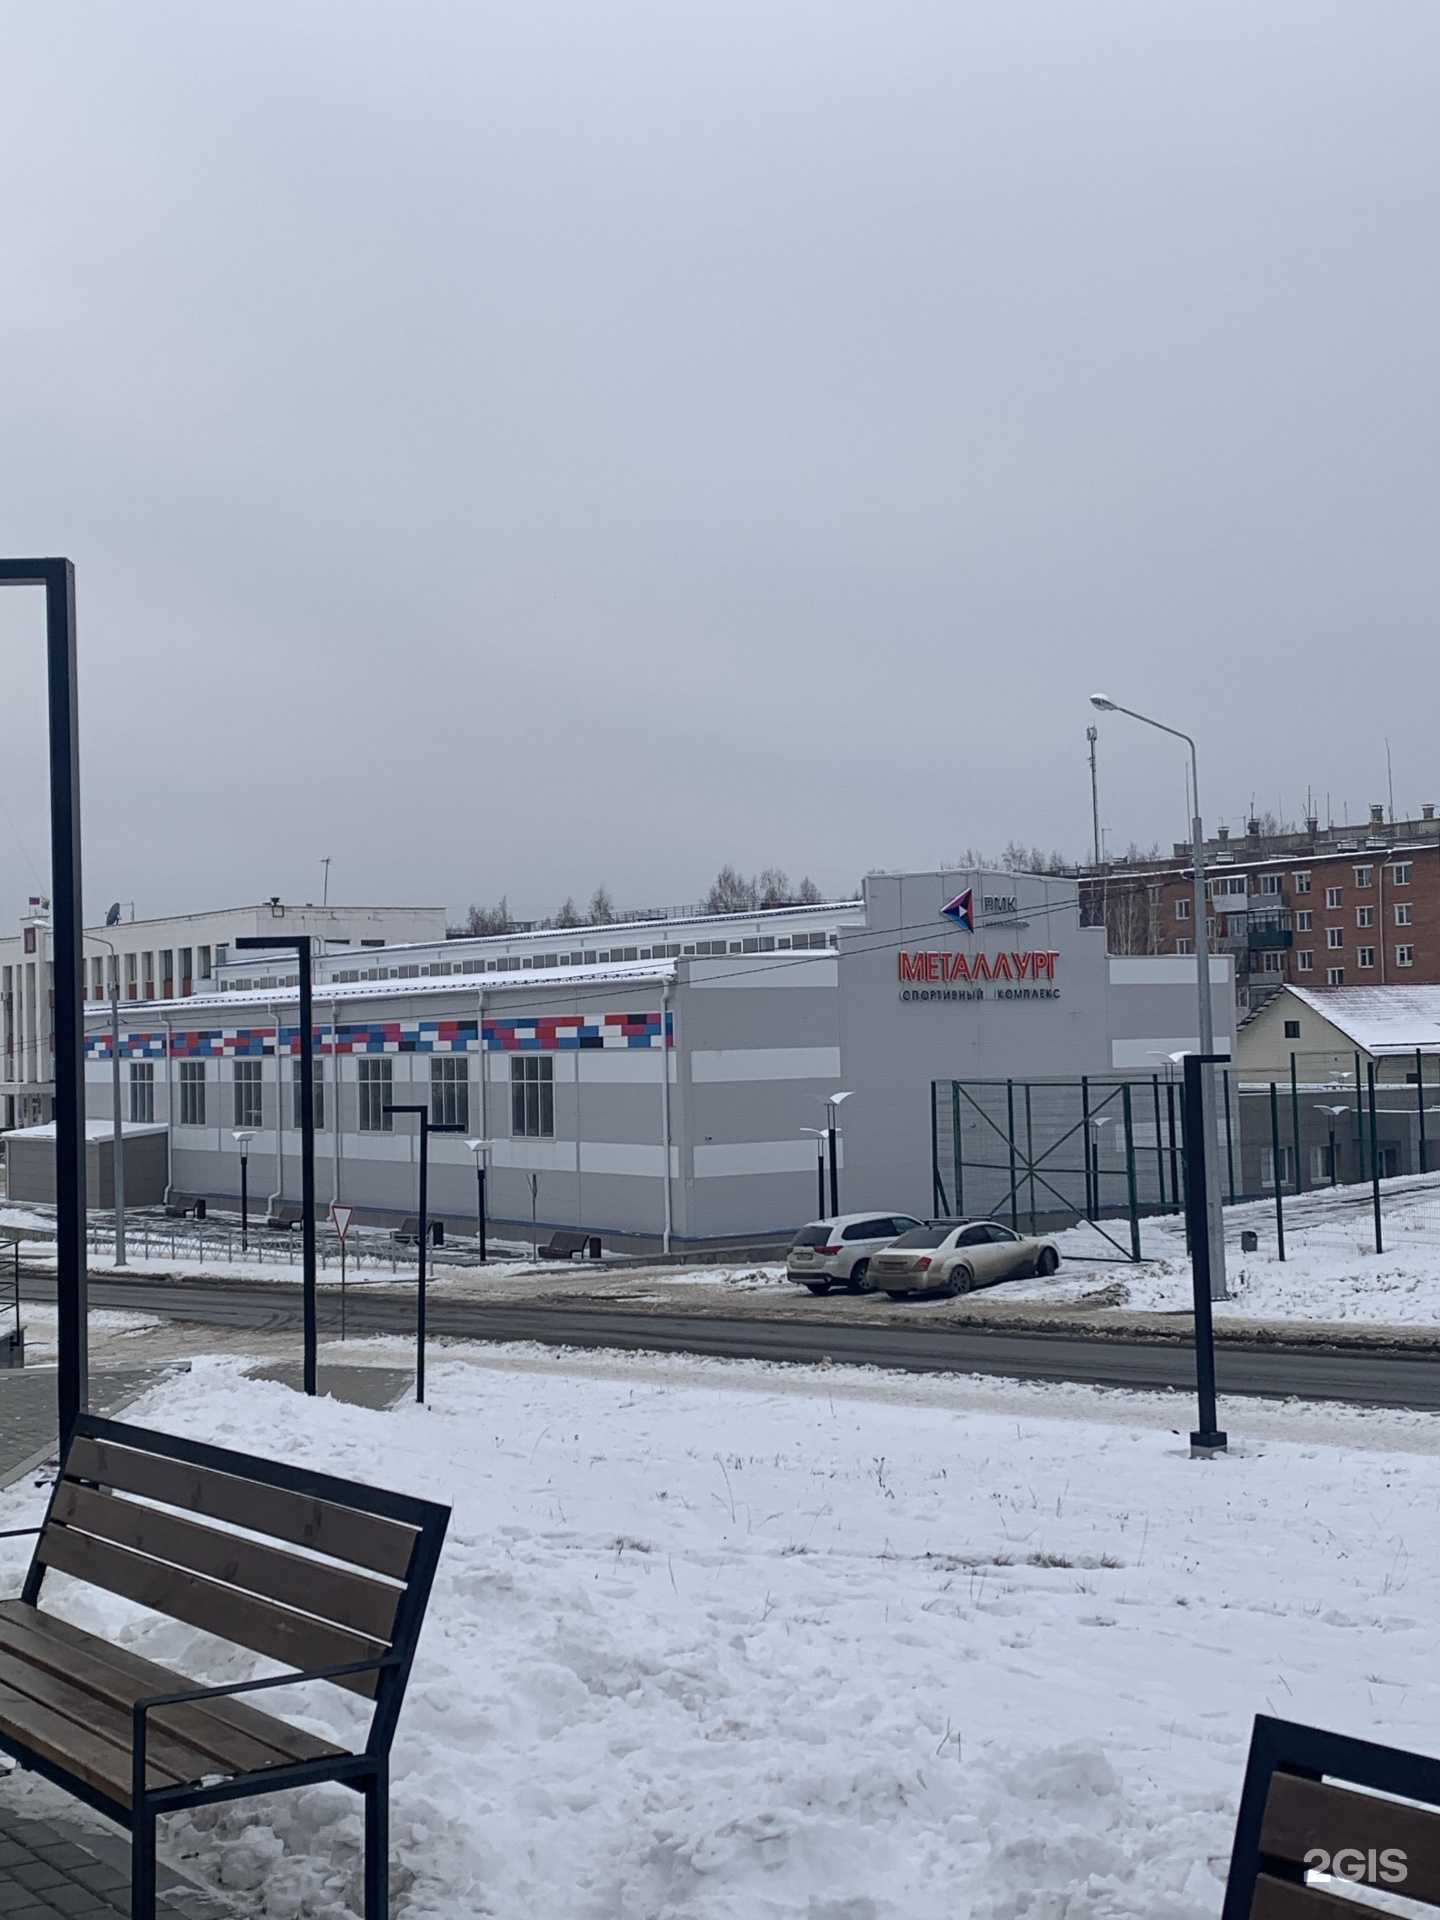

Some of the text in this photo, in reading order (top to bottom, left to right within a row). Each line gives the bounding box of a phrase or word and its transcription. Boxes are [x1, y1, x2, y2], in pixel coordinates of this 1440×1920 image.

[899, 950, 1060, 981] МЕТАЛЛУРГ
[901, 988, 1061, 1001] СПОРТИВНЫЙ КОМПЛЕКС
